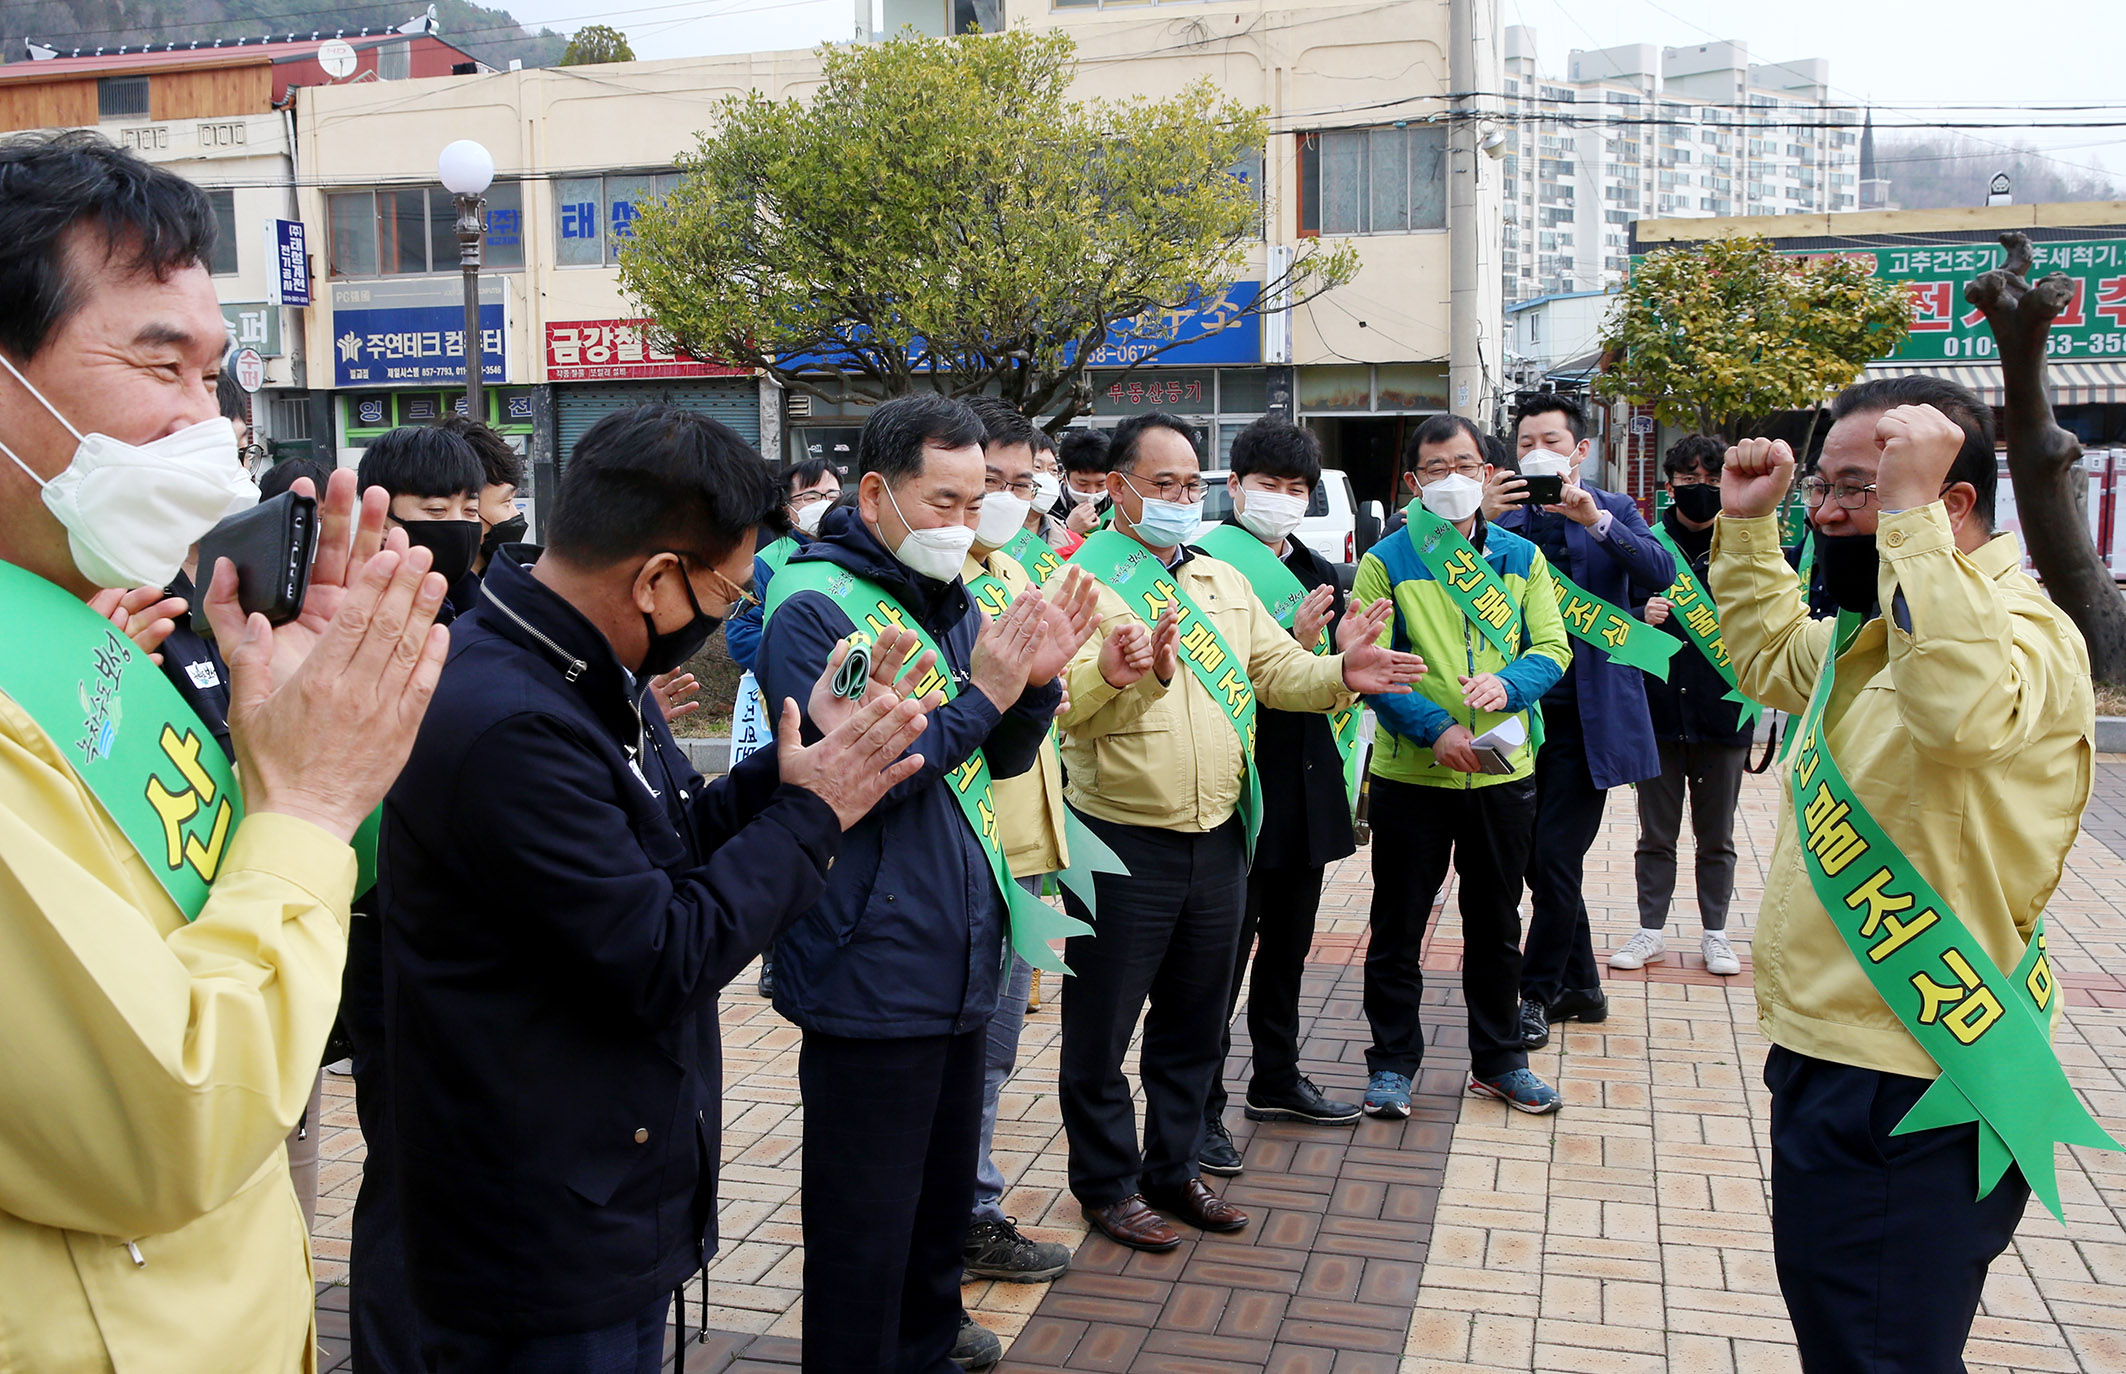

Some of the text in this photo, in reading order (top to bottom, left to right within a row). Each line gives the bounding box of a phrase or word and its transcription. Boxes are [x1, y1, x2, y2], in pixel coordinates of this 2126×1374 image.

[280, 244, 293, 291] 전기공사
[366, 329, 504, 360] 주연테크 컴터
[240, 350, 260, 389] 수퍼
[1107, 380, 1201, 404] 부동산등기
[145, 721, 233, 886] 산
[1795, 704, 2006, 1047] 산불조심
